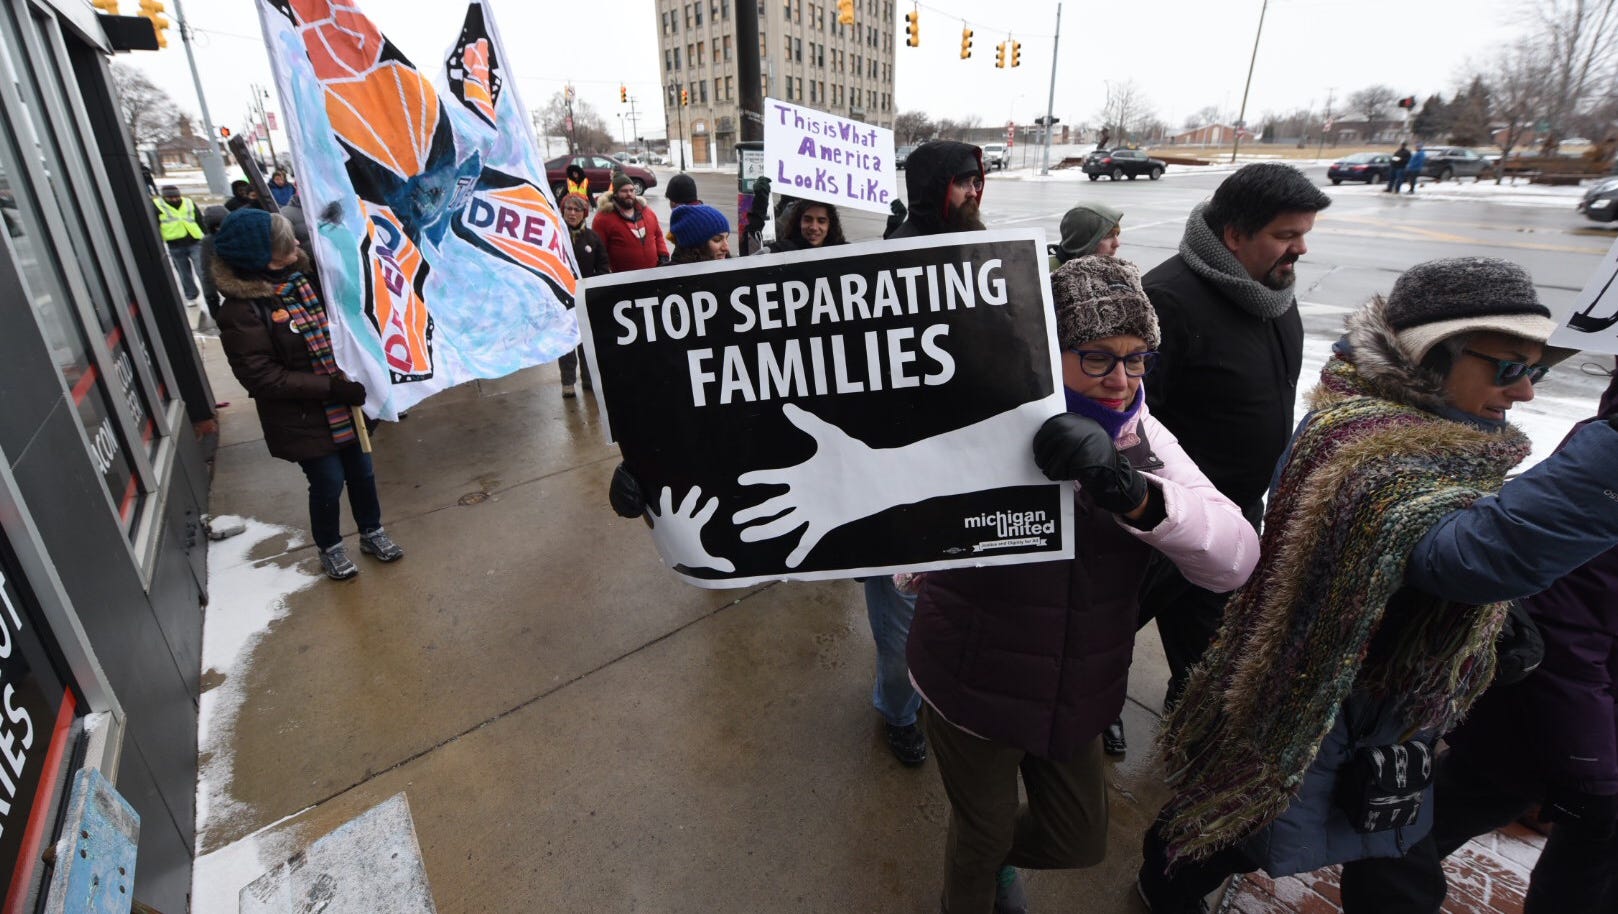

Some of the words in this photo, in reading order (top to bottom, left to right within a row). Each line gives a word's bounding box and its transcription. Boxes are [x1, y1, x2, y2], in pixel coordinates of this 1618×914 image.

[774, 105, 820, 134] This
[824, 121, 837, 138] is
[838, 121, 878, 148] What
[798, 136, 882, 172] America
[468, 197, 567, 264] DREA
[613, 290, 718, 346] STOP
[730, 259, 1008, 333] SEPARATING
[686, 324, 956, 408] FAMILIES
[964, 510, 1046, 529] michigan
